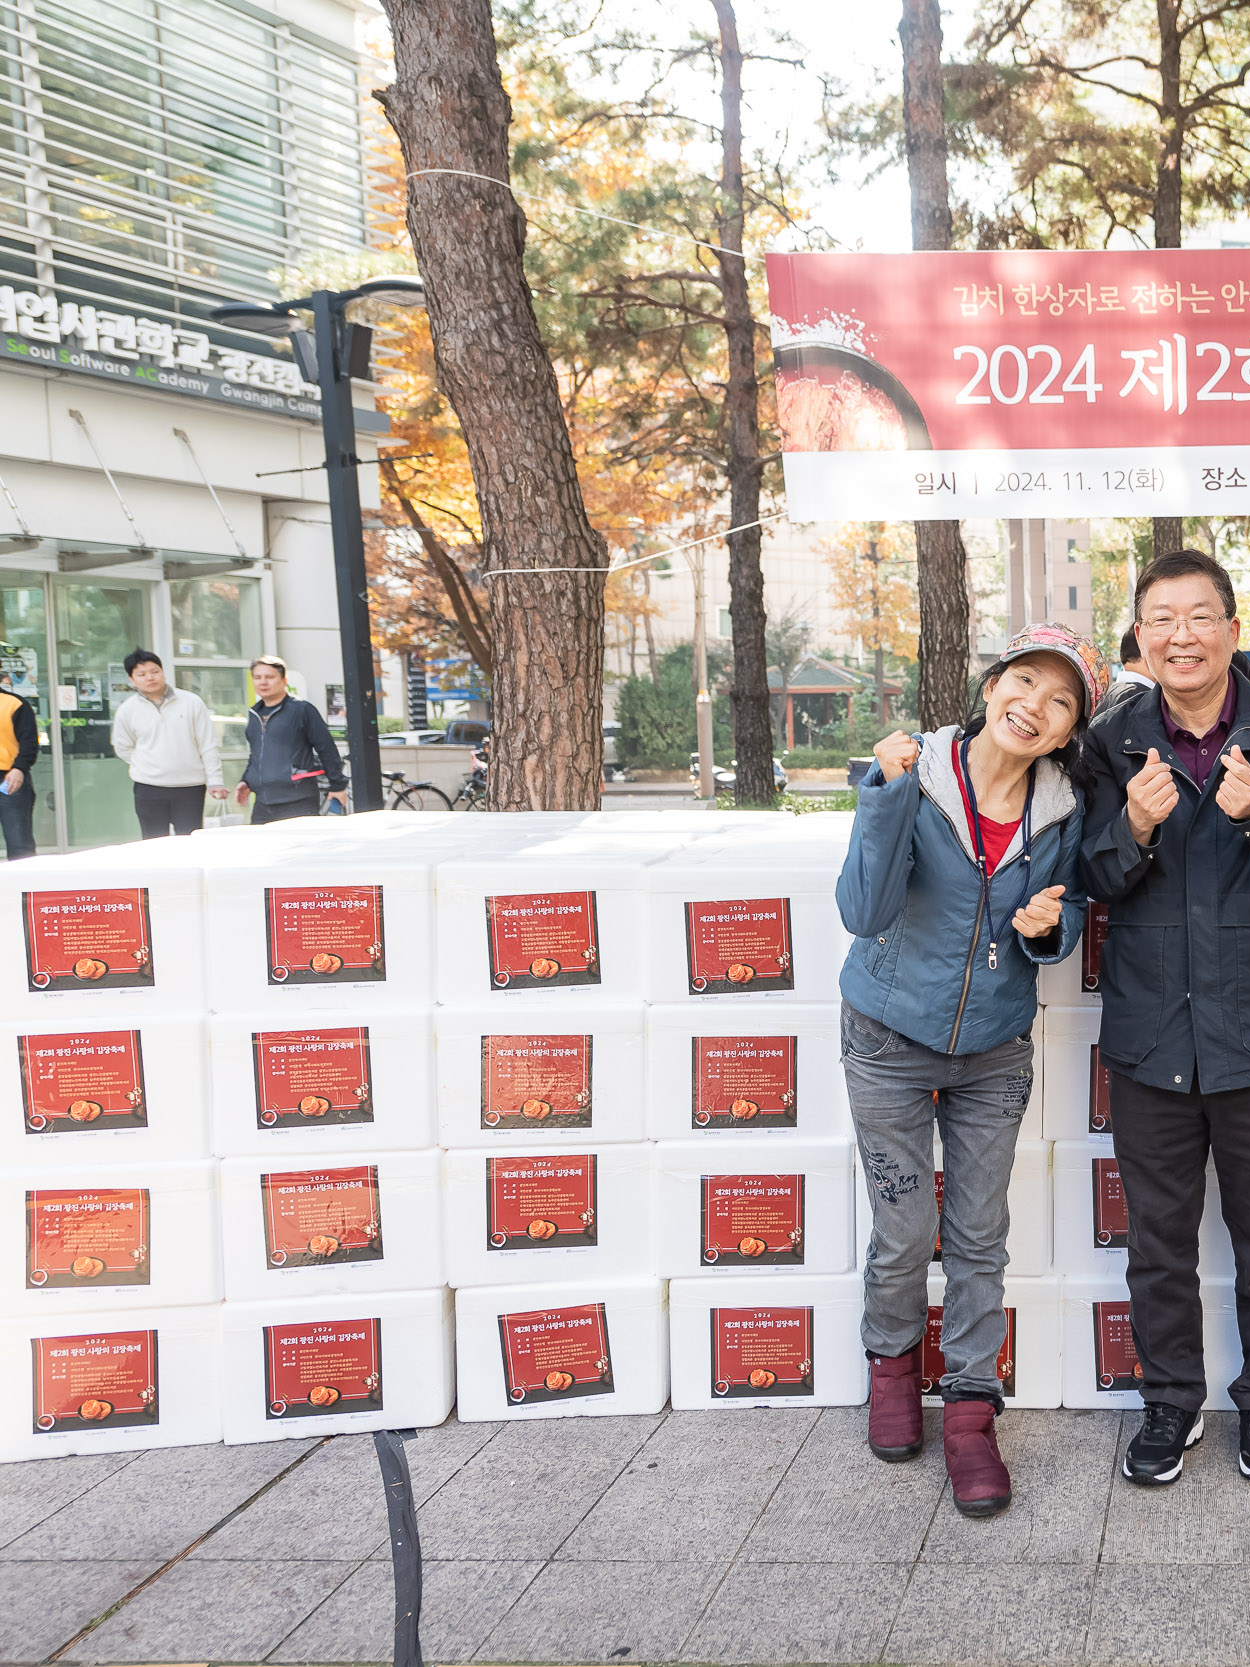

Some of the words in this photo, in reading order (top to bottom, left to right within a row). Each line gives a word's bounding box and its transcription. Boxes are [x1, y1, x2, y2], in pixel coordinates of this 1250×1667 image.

[953, 283, 1004, 317] 김치
[1012, 282, 1126, 316] 한상자로
[1131, 281, 1215, 314] 전하는
[7, 339, 57, 362] Seoul
[59, 350, 131, 377] Software
[220, 383, 284, 408] Gwangjin
[953, 344, 1103, 405] 2024
[915, 472, 956, 495] 일시
[995, 472, 1052, 492] 2024.
[1063, 471, 1091, 491] 11.
[1102, 468, 1165, 492] 12(화)
[1201, 467, 1247, 491] 장소
[39, 905, 60, 914] 제2회
[77, 904, 101, 913] 사랑의
[102, 902, 133, 912] 김장축제
[699, 914, 716, 923] 제2회
[730, 913, 750, 921] 사랑의
[751, 911, 777, 921] 김장축제
[35, 1048, 55, 1057] 제2회
[71, 1046, 95, 1055] 사랑의
[95, 1044, 125, 1054] 김장축제
[706, 1050, 722, 1058] 제2회
[737, 1049, 756, 1057] 사랑의
[758, 1049, 783, 1057] 김장축제
[543, 1313, 561, 1321] 2024
[724, 1321, 740, 1329] 제2회
[755, 1320, 774, 1328] 사랑의
[775, 1319, 799, 1327] 김장축제
[513, 1324, 531, 1334] 제2회
[545, 1320, 565, 1330] 사랑의
[566, 1317, 592, 1328] 김장축제
[279, 1336, 298, 1346] 제2회
[314, 1334, 336, 1343] 사랑의
[337, 1331, 365, 1342] 김장축제
